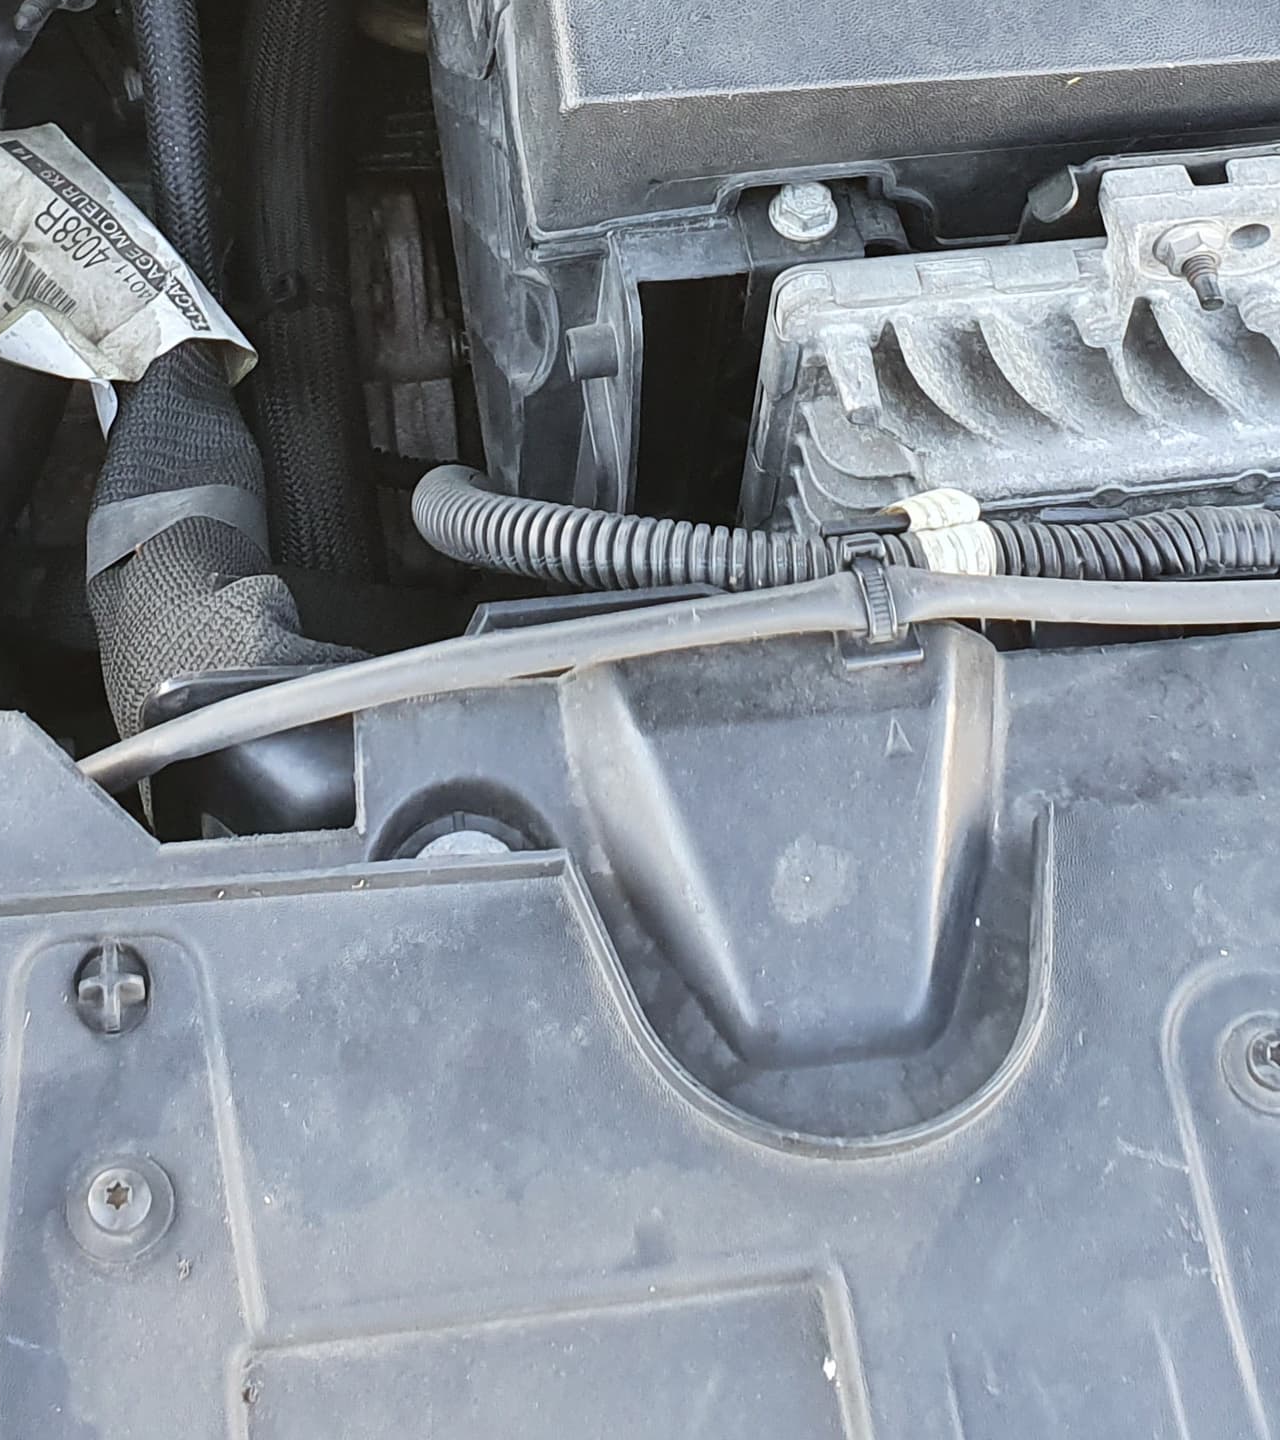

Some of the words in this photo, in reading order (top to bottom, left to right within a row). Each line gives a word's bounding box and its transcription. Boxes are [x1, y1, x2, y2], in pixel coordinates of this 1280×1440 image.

[41, 167, 65, 188] K9
[34, 198, 109, 268] 4058R
[64, 186, 130, 249] MOTEUR
